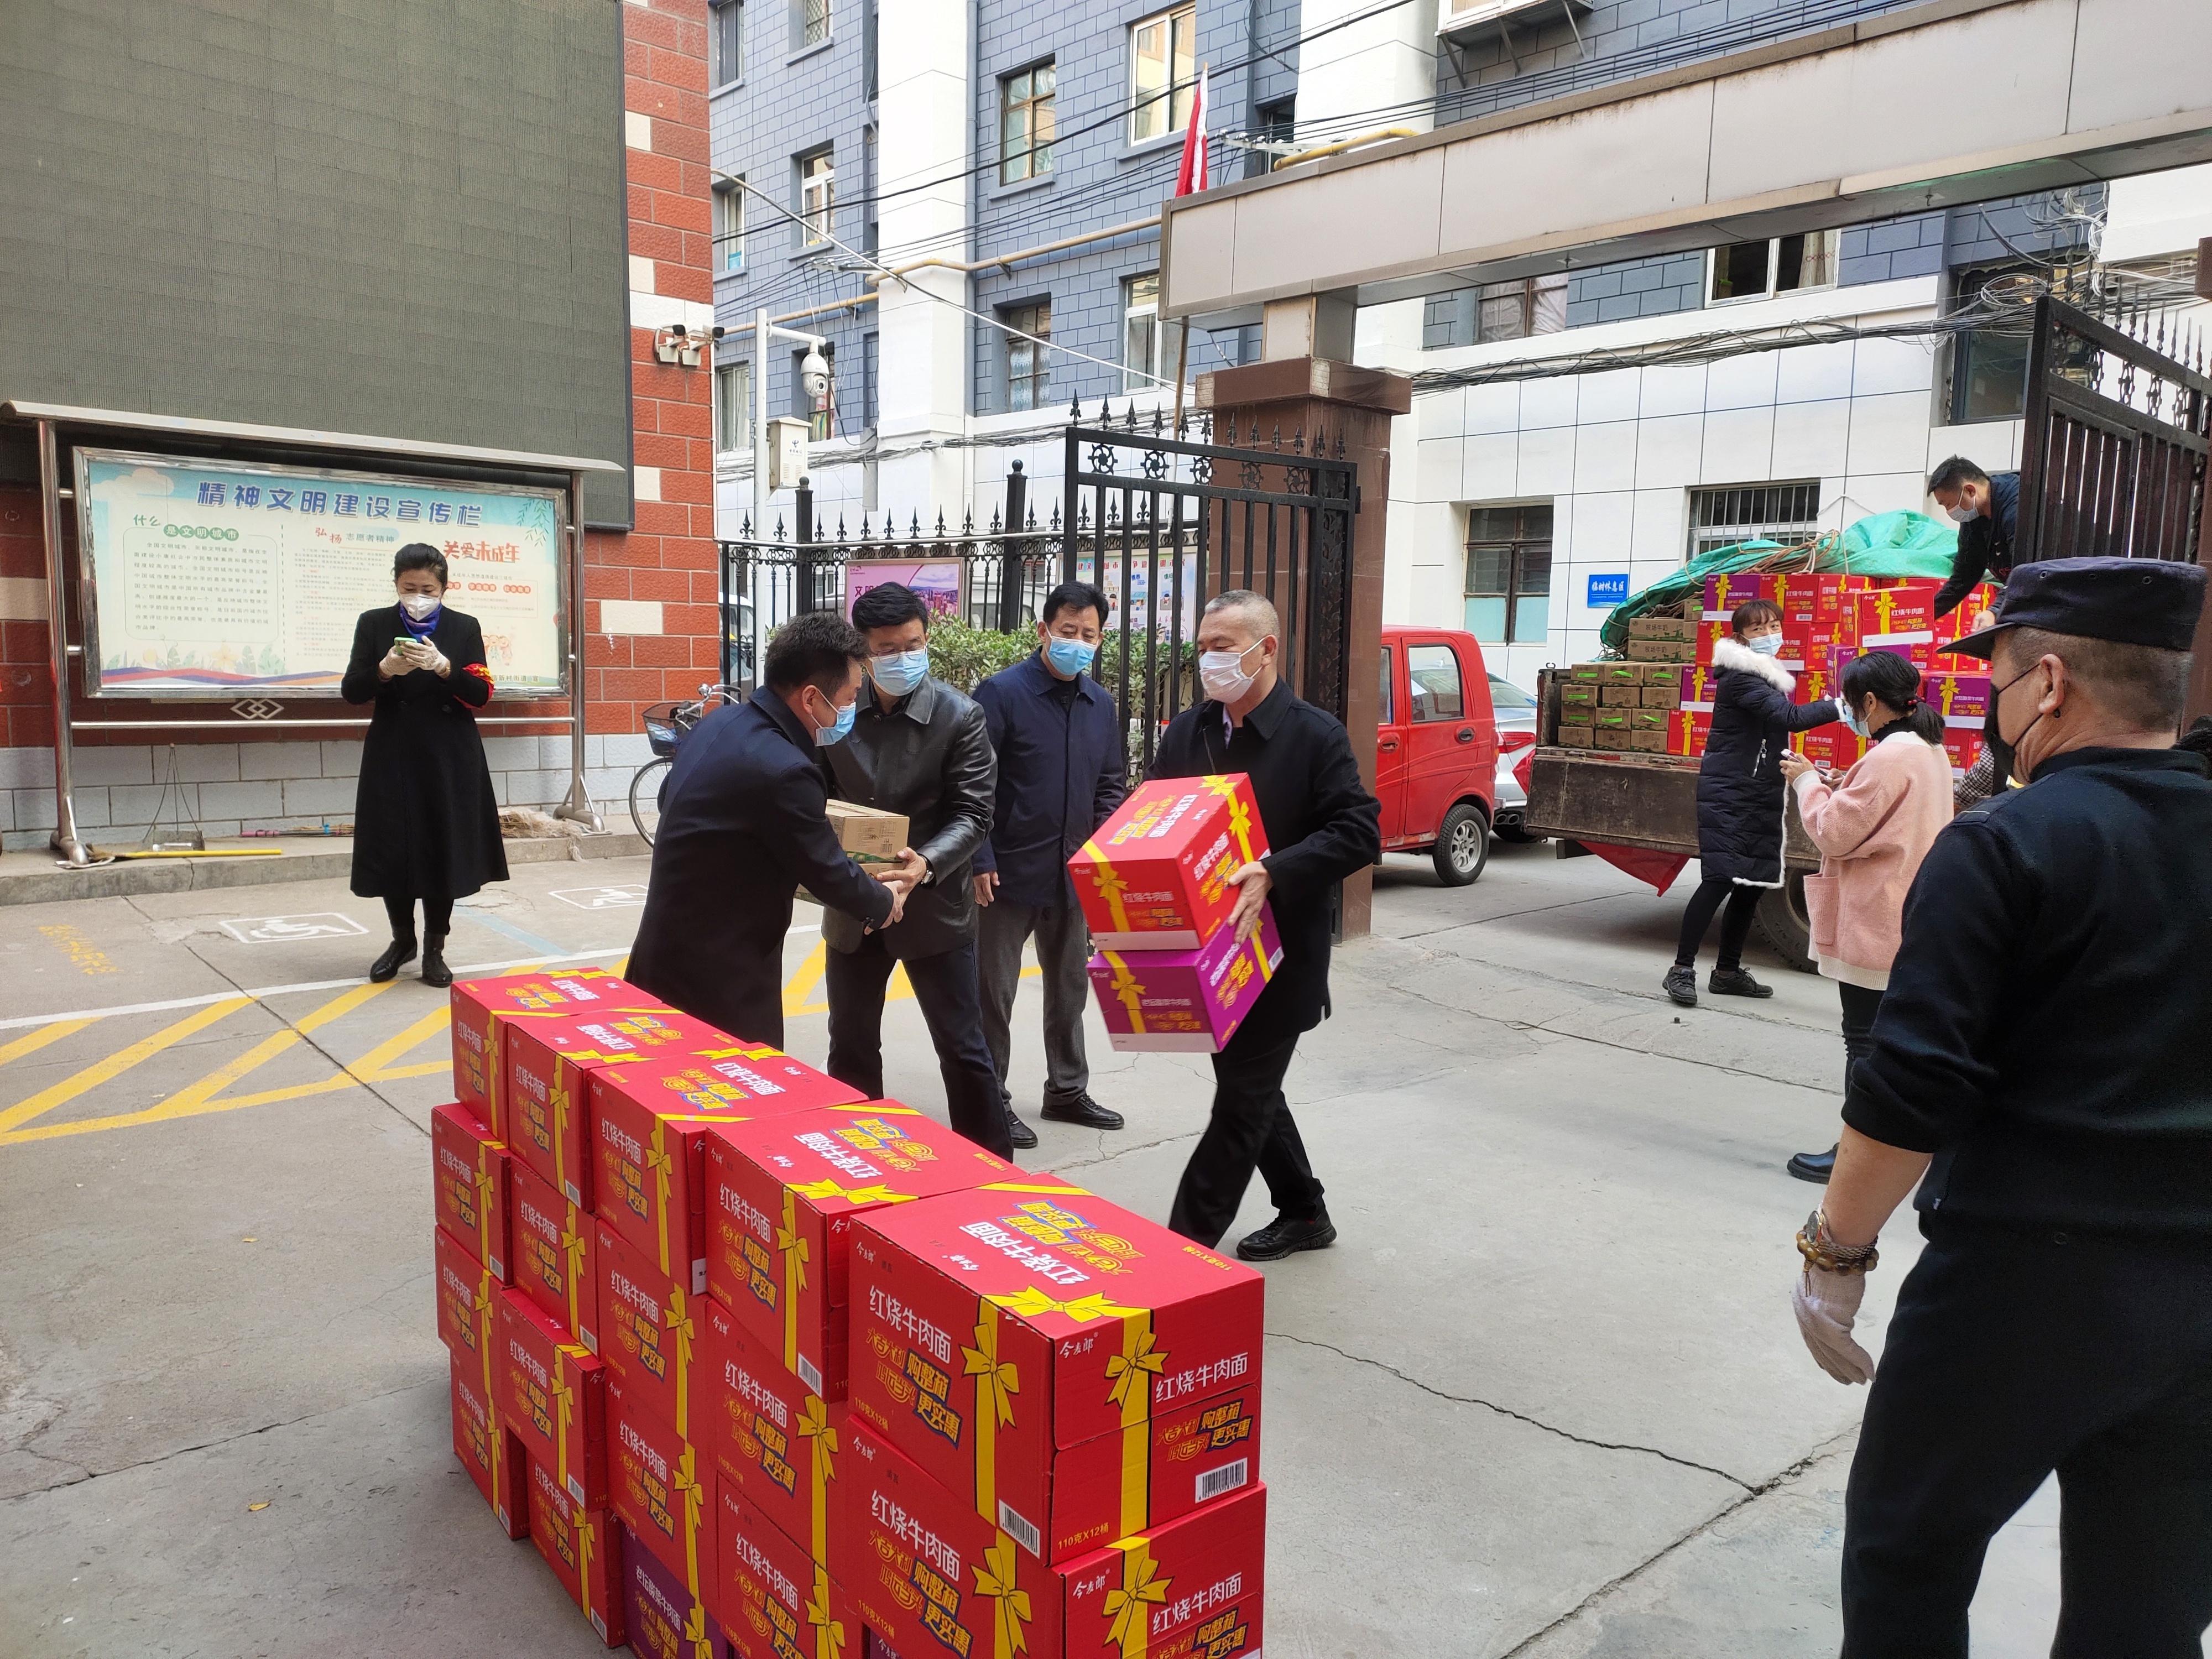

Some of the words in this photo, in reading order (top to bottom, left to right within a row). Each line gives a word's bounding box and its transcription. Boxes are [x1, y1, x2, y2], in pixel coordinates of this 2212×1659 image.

[197, 482, 482, 527] 精神文明建设宣传栏
[133, 514, 160, 526] 什么
[166, 525, 237, 540] 是文明城市
[315, 527, 342, 544] 弘扬
[346, 533, 394, 544] 志愿者精神
[444, 540, 520, 563] 关爱未成年
[1078, 561, 1118, 571] 建文城市
[1891, 608, 1924, 616] 红烧牛肉面
[516, 1063, 546, 1102] 红烧牛肉面
[712, 1062, 786, 1095] 红烧牛肉面
[601, 1118, 641, 1165] 红烧牛肉面
[794, 1132, 883, 1179] 红烧牛肉面
[441, 1146, 471, 1183] 红烧牛肉面
[521, 1200, 557, 1244] 红烧牛肉面
[720, 1182, 770, 1243] 红烧牛肉面
[744, 1235, 770, 1275] 购整箱
[959, 1222, 1091, 1285] 红烧牛肉面
[443, 1265, 470, 1307] 红烧牛肉面
[611, 1270, 659, 1323] 红烧牛肉面
[750, 1267, 777, 1310] 更实惠
[869, 1285, 951, 1364] 红烧牛肉面
[510, 1339, 546, 1388] 红烧牛肉面
[1059, 1337, 1094, 1359] 今麦郎
[725, 1360, 787, 1428] 红烧牛肉面
[906, 1351, 950, 1401] 购整箱
[1156, 1352, 1248, 1403] 红烧牛肉面
[754, 1415, 787, 1457] 购整箱
[854, 1397, 889, 1431] 110克X12桶
[917, 1390, 961, 1442] 更实惠
[1202, 1400, 1241, 1430] 购整箱
[1211, 1417, 1253, 1447] 更实惠
[619, 1420, 667, 1482] 红烧牛肉面
[762, 1450, 796, 1494] 更实惠
[535, 1463, 568, 1519] 红烧牛肉面
[871, 1489, 960, 1582] 红烧牛肉面
[1057, 1522, 1109, 1550] 110克X12桶
[736, 1533, 798, 1611] 红烧牛肉面
[914, 1559, 960, 1615] 购整箱
[1073, 1574, 1105, 1599] 今麦郎
[636, 1565, 681, 1631] 老坛酸菜牛肉面
[766, 1594, 797, 1642] 购整箱
[858, 1599, 895, 1639] 110克X12桶
[1153, 1572, 1242, 1635] 红烧牛肉面
[924, 1601, 972, 1658] 更实惠
[1197, 1610, 1237, 1646] 购整箱
[1206, 1623, 1247, 1659] 更实惠
